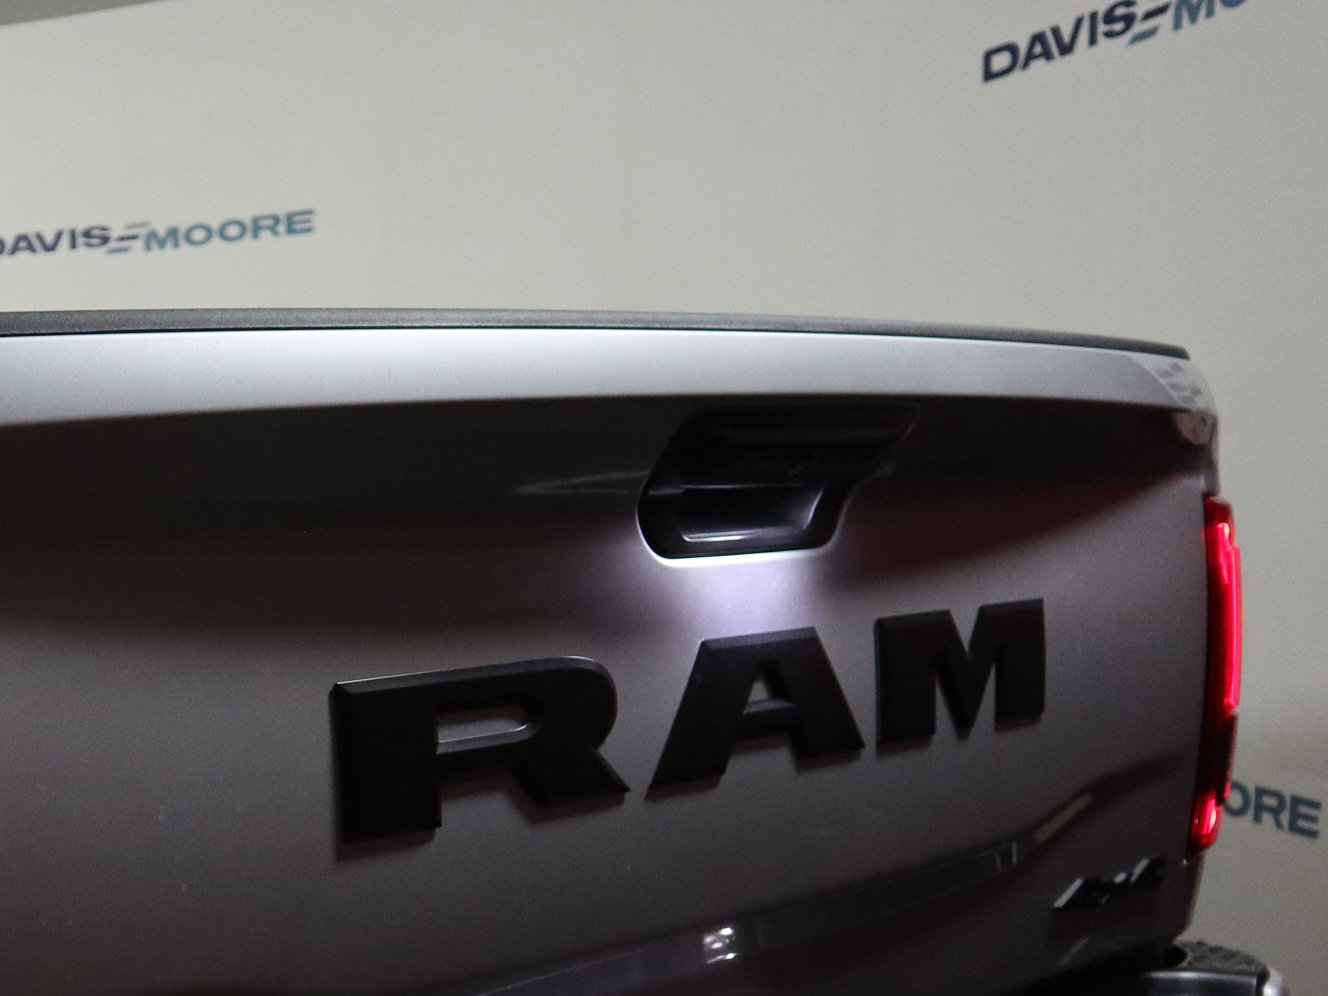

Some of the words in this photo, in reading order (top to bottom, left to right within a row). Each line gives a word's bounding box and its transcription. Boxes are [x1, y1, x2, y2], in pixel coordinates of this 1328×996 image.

[982, 0, 1138, 83] DAVIS
[143, 209, 315, 251] MOORE
[329, 598, 1046, 844] RAM
